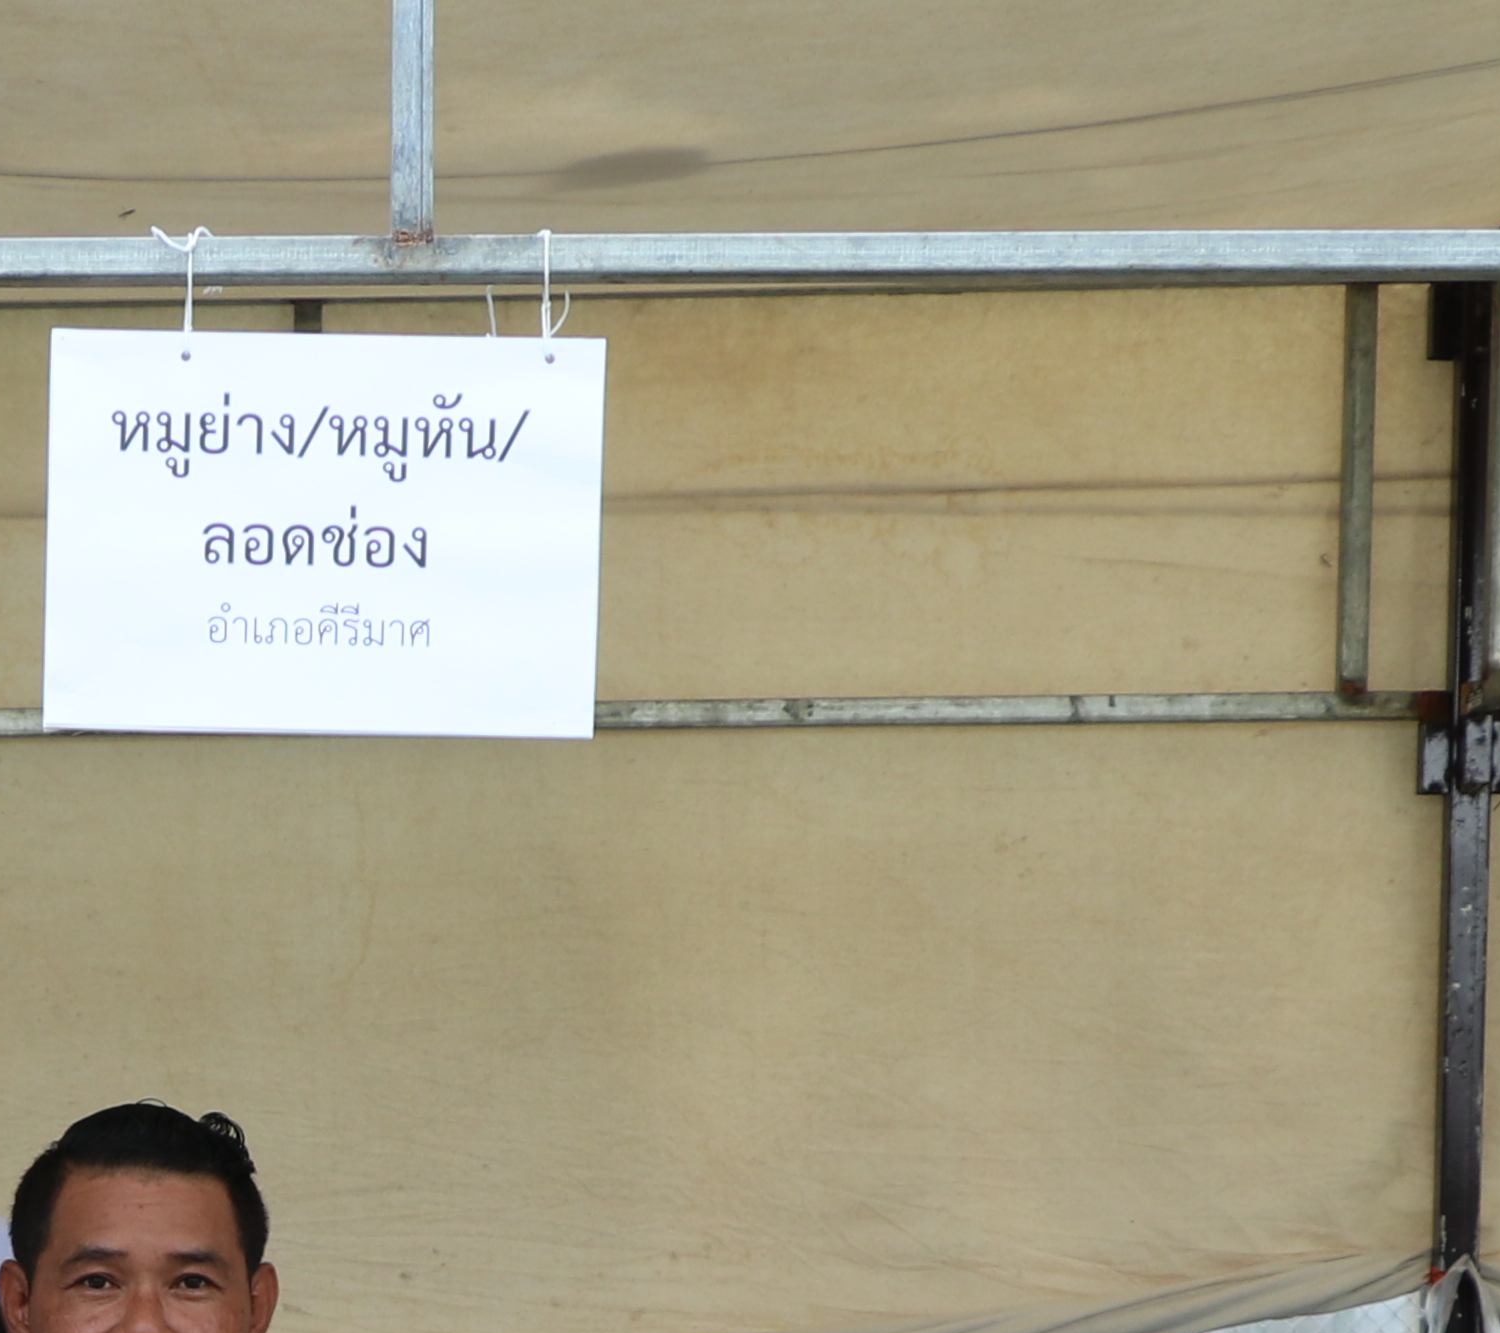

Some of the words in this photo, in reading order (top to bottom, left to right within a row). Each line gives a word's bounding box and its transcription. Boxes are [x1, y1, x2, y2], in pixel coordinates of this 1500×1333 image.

[111, 393, 531, 482] หมูย่าง/หมูหัน/
[201, 505, 429, 569] ลอดช่อง
[207, 602, 432, 648] อำเภอคีรีมาศ
